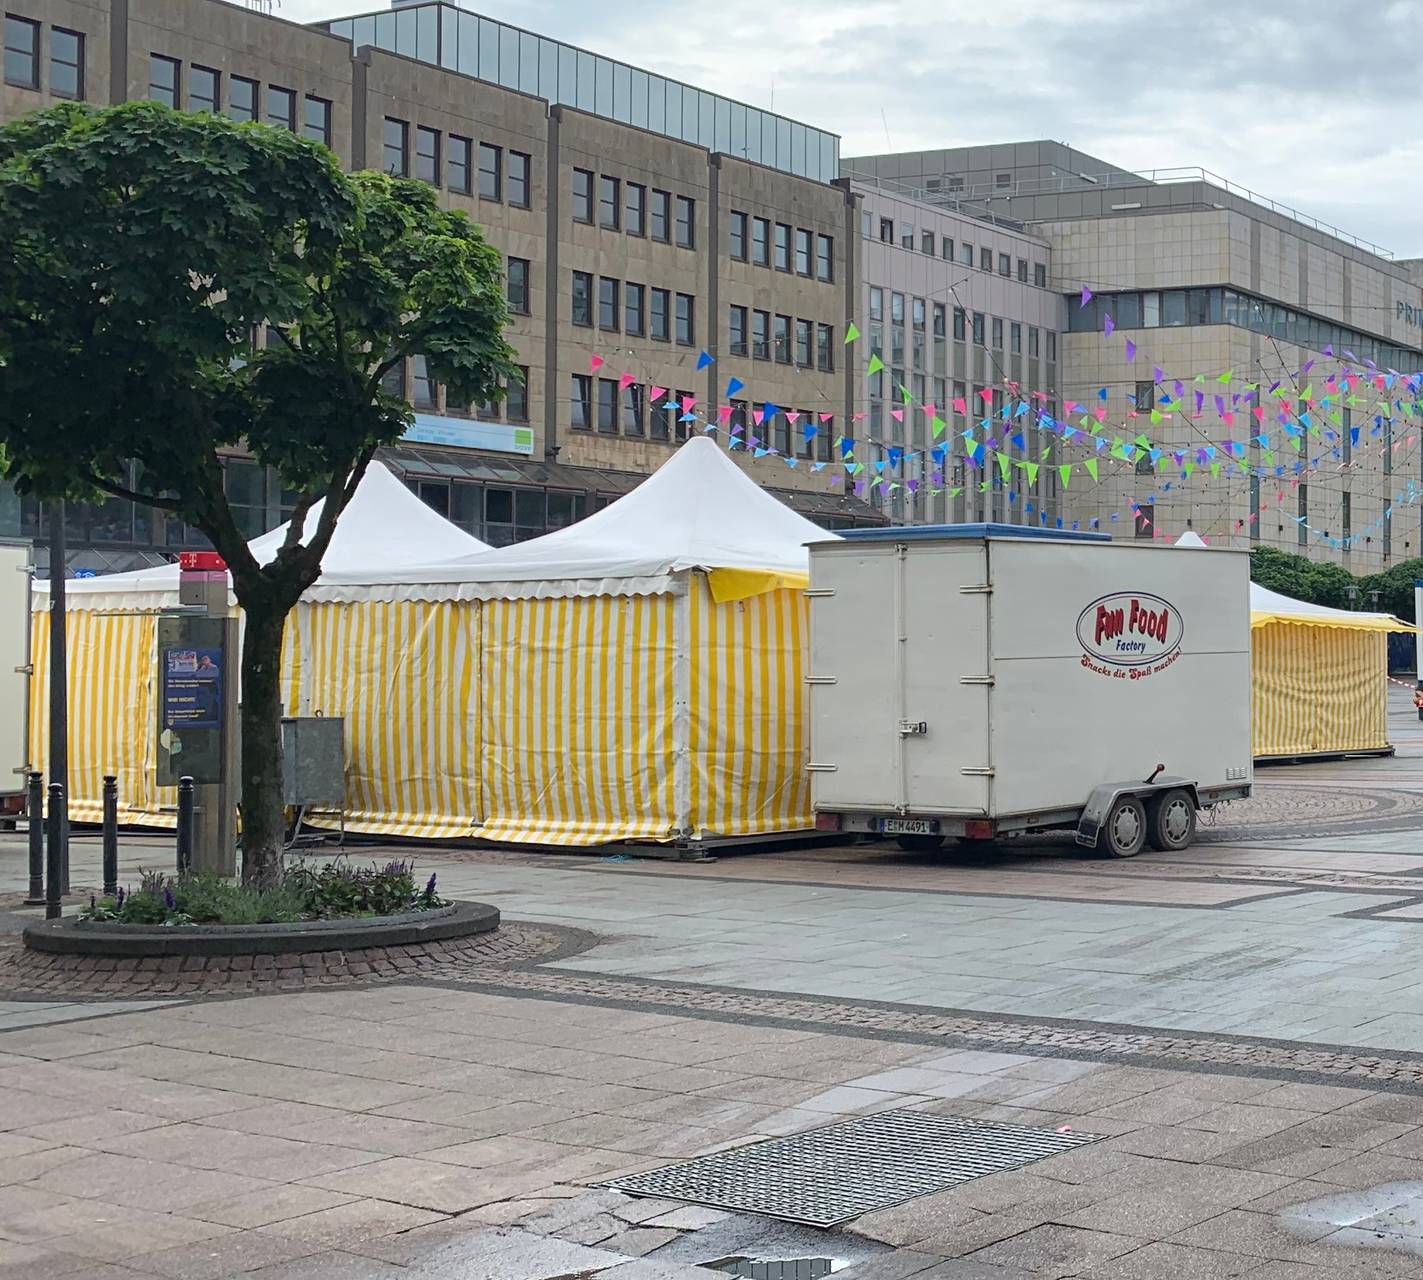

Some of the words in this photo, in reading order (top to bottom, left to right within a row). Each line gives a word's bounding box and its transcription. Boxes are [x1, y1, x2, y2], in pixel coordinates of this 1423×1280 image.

[1095, 604, 1124, 646] Fun
[1128, 599, 1169, 645] Food
[1116, 639, 1146, 654] Factory
[1081, 653, 1111, 676] Snacks
[1113, 668, 1126, 679] die
[1128, 665, 1152, 680] Spaß
[1154, 646, 1182, 672] machen!
[887, 820, 893, 831] E
[905, 821, 927, 833] 4491
